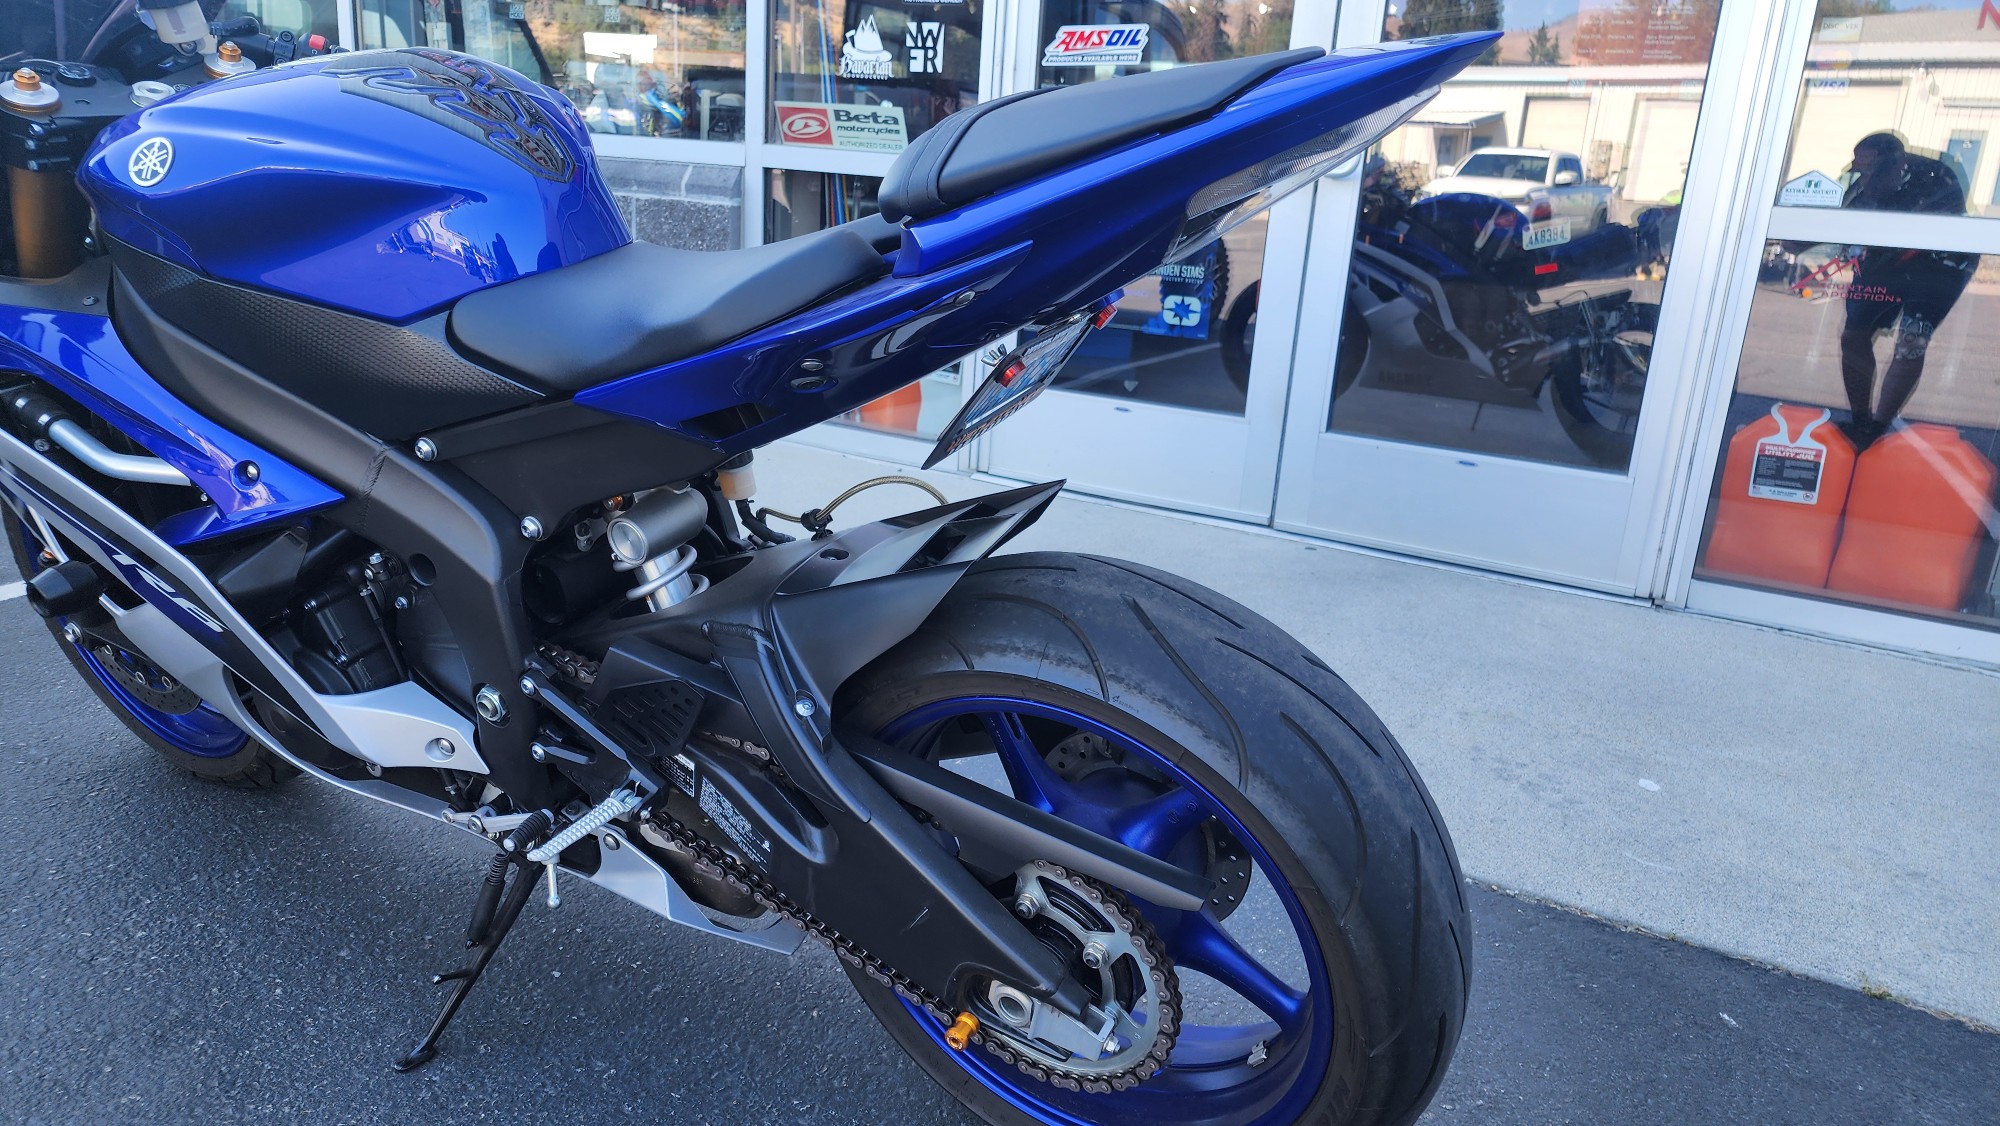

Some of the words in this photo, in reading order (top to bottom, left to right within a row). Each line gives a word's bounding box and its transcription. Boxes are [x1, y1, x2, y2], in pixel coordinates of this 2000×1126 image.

[1823, 22, 1859, 30] DISCVER
[1055, 29, 1142, 52] AMSOIL
[1047, 54, 1082, 63] PRODUCTS
[1083, 54, 1118, 62] AVAILABLE
[837, 54, 895, 77] Bavarian
[833, 109, 899, 125] Beta
[836, 125, 901, 135] motorcycles
[839, 141, 879, 149] AUTHORIZED
[880, 143, 904, 151] DEALER
[1181, 265, 1205, 279] SIMS
